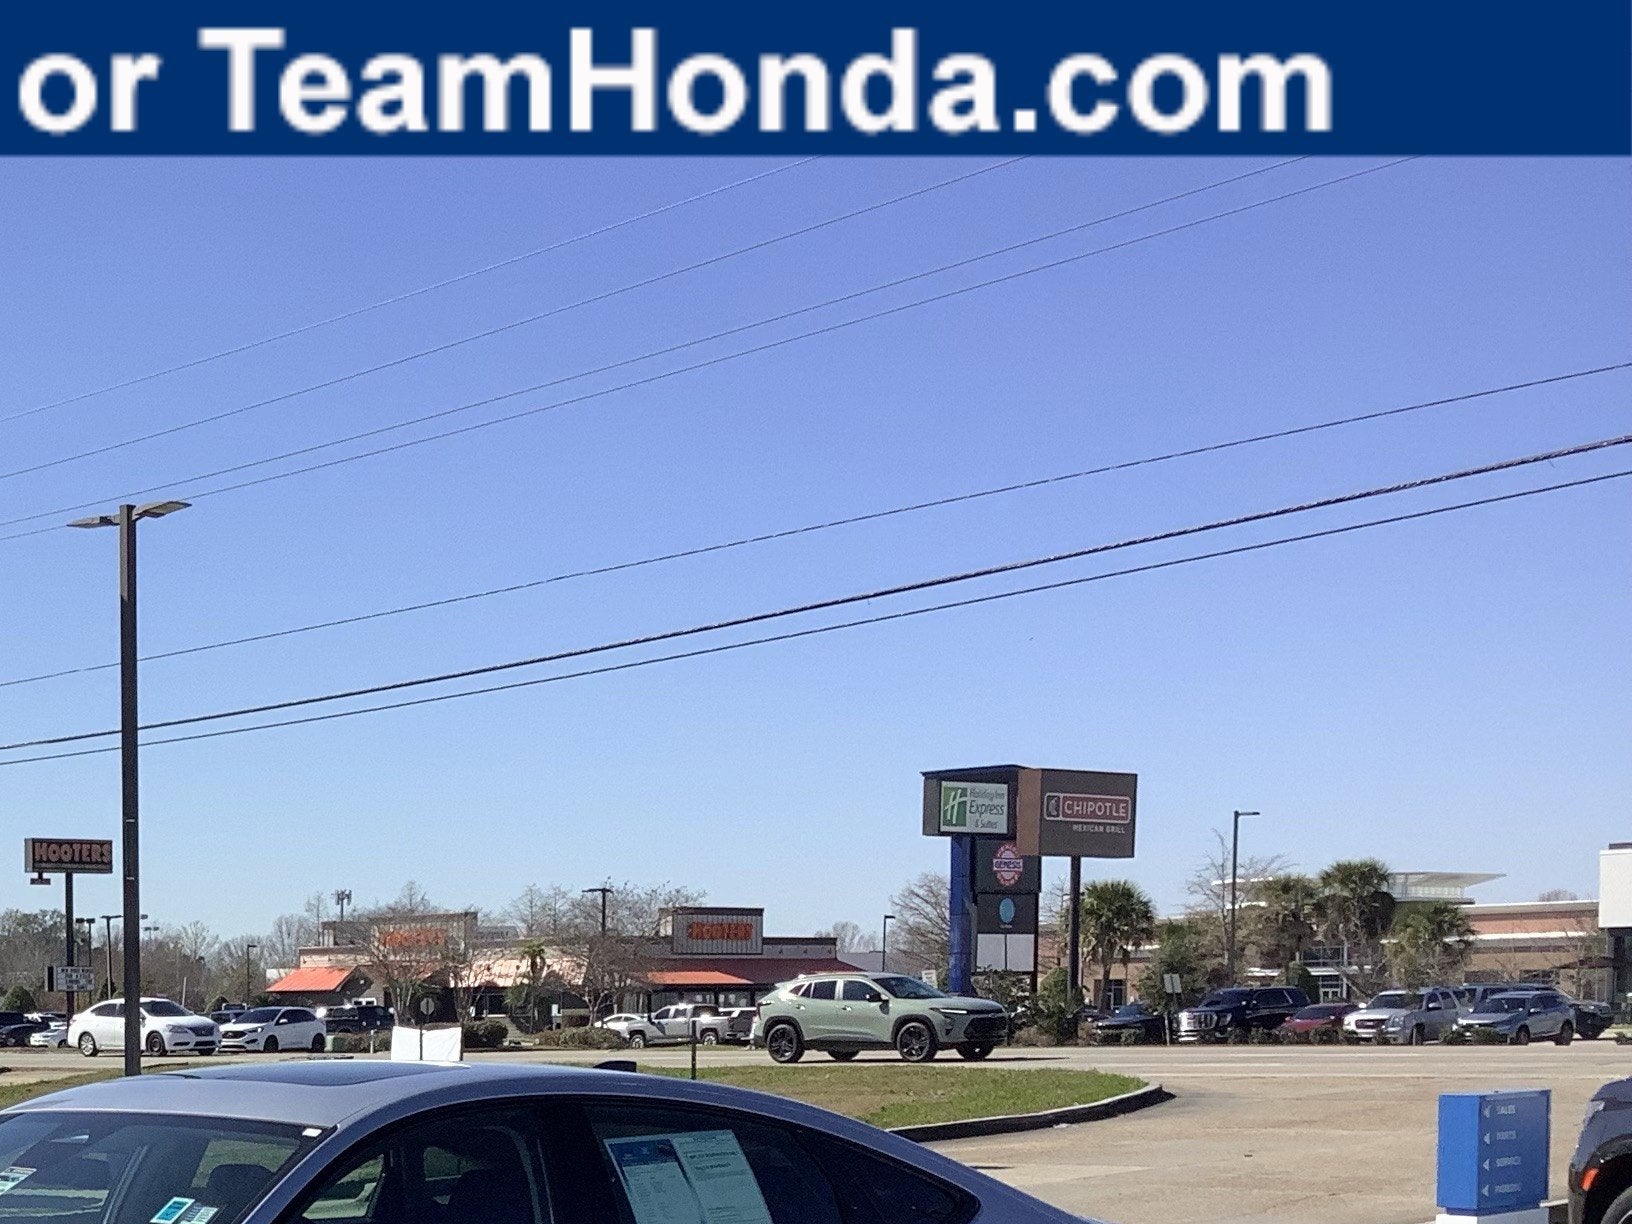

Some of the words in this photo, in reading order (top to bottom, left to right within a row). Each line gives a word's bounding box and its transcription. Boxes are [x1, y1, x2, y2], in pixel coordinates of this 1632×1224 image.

[969, 801, 1005, 817] Express
[1063, 800, 1127, 817] CHIPOTLE
[1072, 823, 1104, 833] MEXICAN
[1106, 825, 1126, 834] GRILL
[34, 842, 111, 863] HOOTERS
